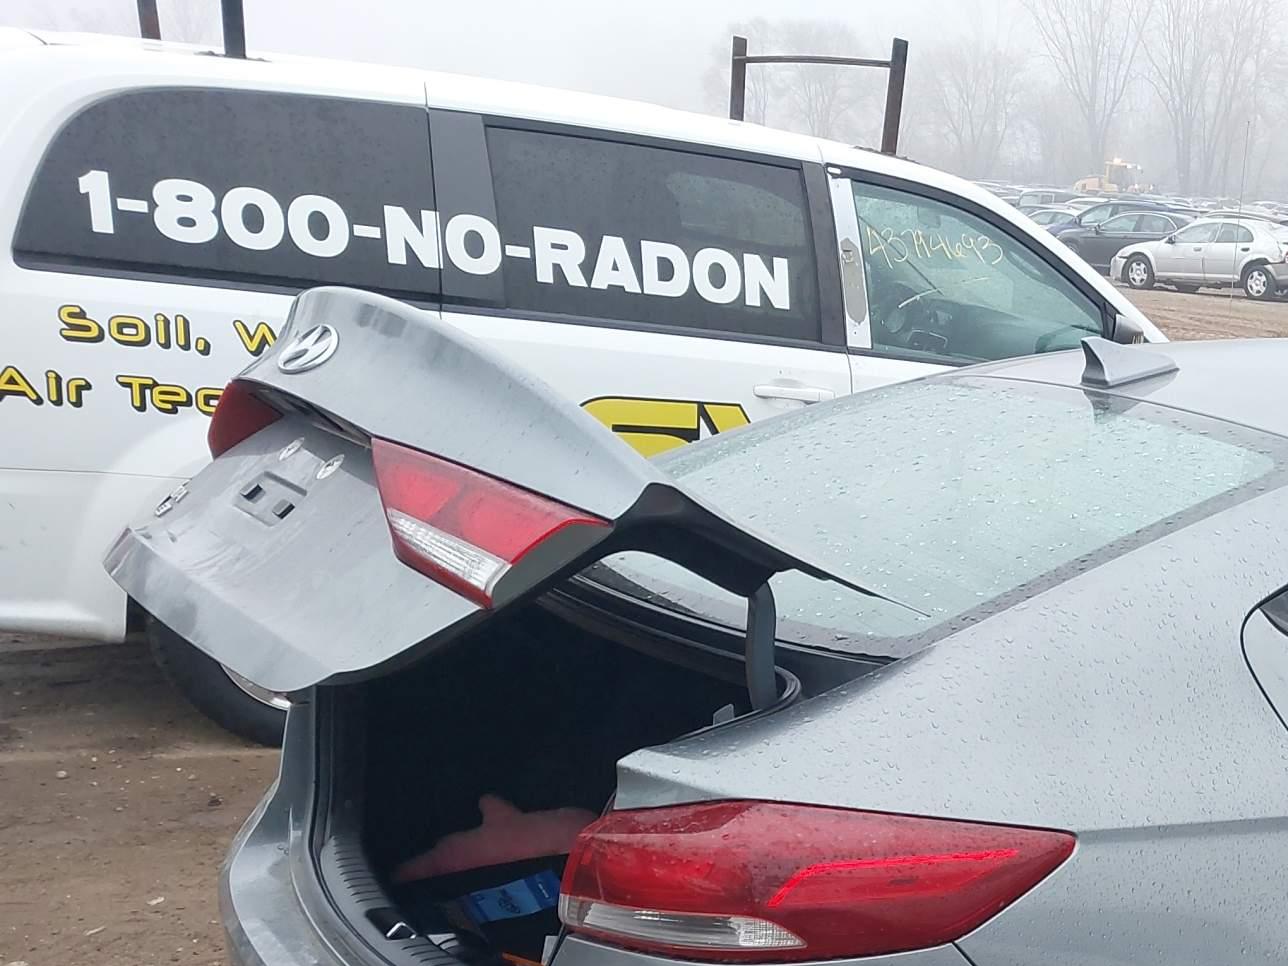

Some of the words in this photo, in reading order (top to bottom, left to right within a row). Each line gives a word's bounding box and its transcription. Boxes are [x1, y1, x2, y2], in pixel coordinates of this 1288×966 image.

[78, 169, 790, 310] 1-800-NO-RADON
[58, 304, 211, 357] Soil,
[0, 365, 92, 409] Air
